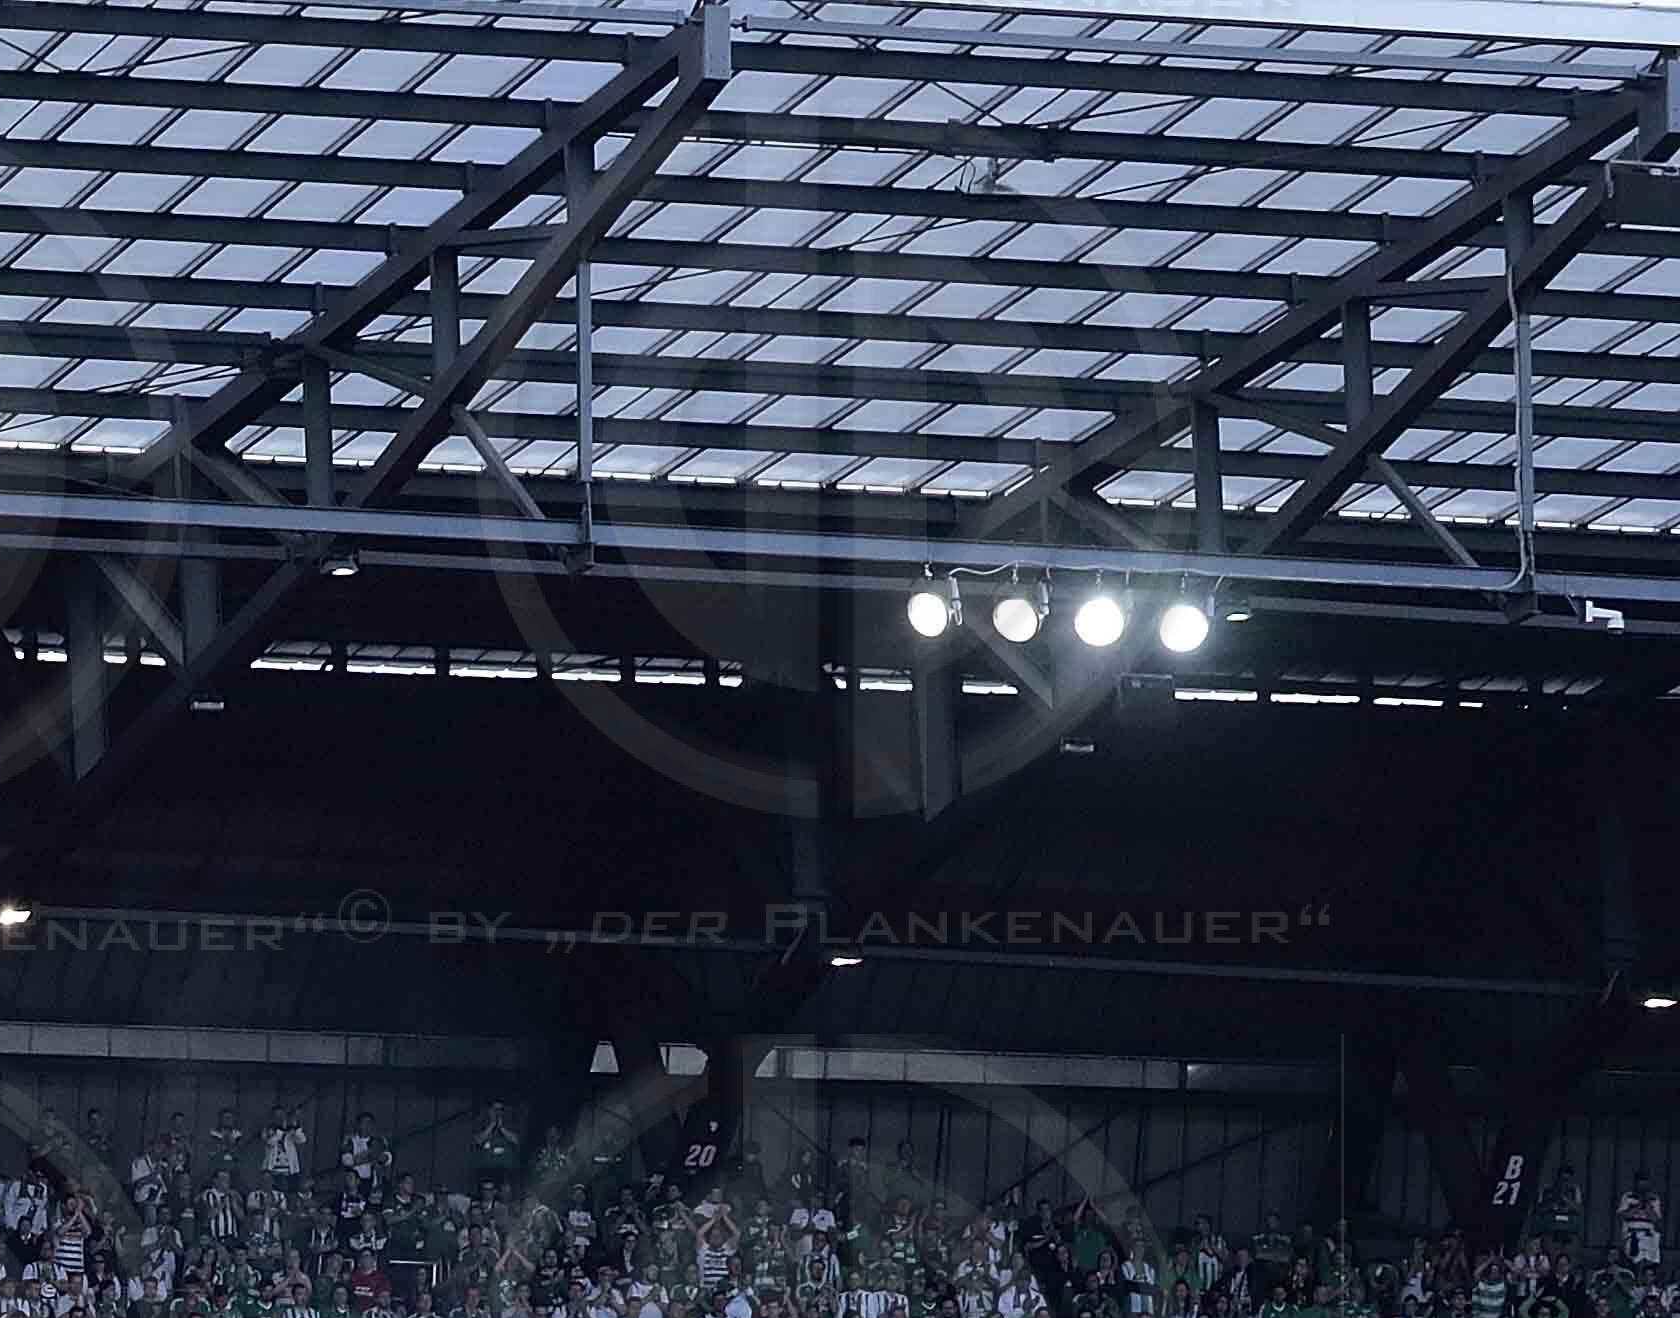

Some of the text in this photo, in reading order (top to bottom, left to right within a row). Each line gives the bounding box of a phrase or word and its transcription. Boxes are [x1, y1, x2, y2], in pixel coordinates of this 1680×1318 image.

[685, 1145, 716, 1167] 20
[1504, 1155, 1522, 1179] B
[1493, 1180, 1520, 1205] 21
